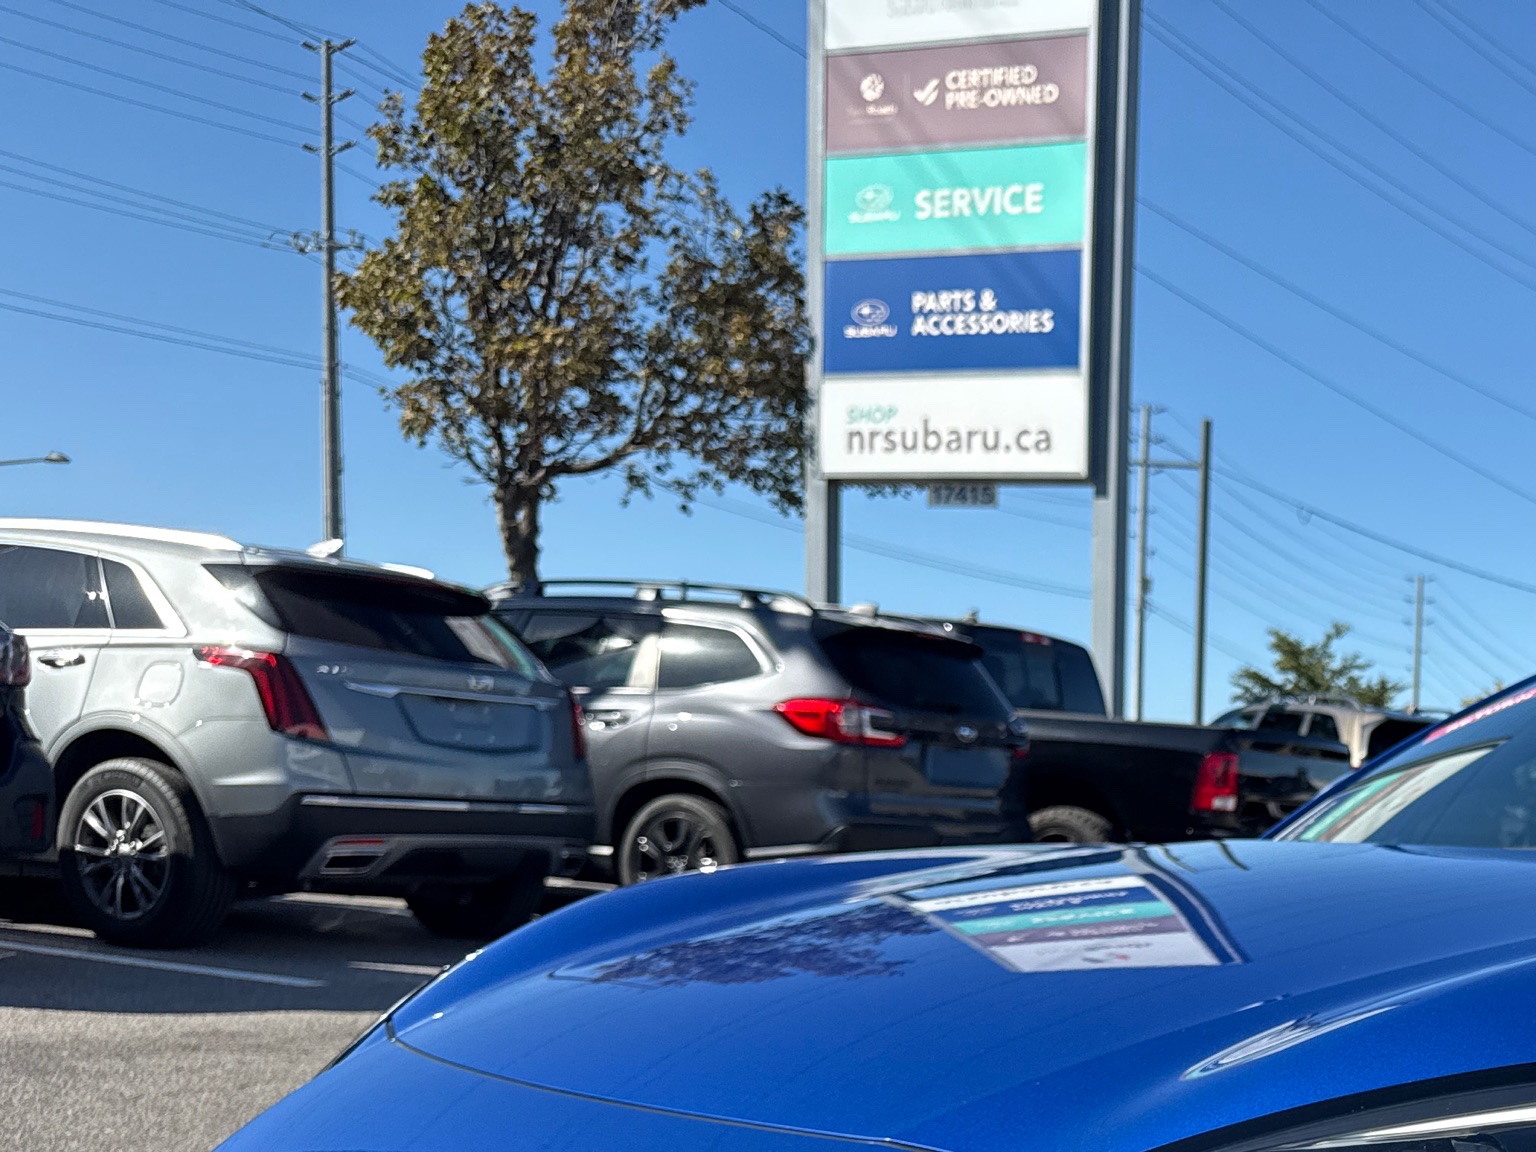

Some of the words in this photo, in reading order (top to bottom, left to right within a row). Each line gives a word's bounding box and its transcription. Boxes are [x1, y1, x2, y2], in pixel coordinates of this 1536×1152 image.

[945, 64, 1038, 90] CERTIFIED
[945, 83, 1060, 110] PRE-OWNED
[914, 182, 1045, 220] SERVICE
[911, 289, 976, 314] PARTS
[978, 288, 998, 311] &
[910, 309, 1055, 336] ACCESSORIES
[846, 405, 898, 424] SHOP
[847, 416, 1052, 453] nrsubaru.ca
